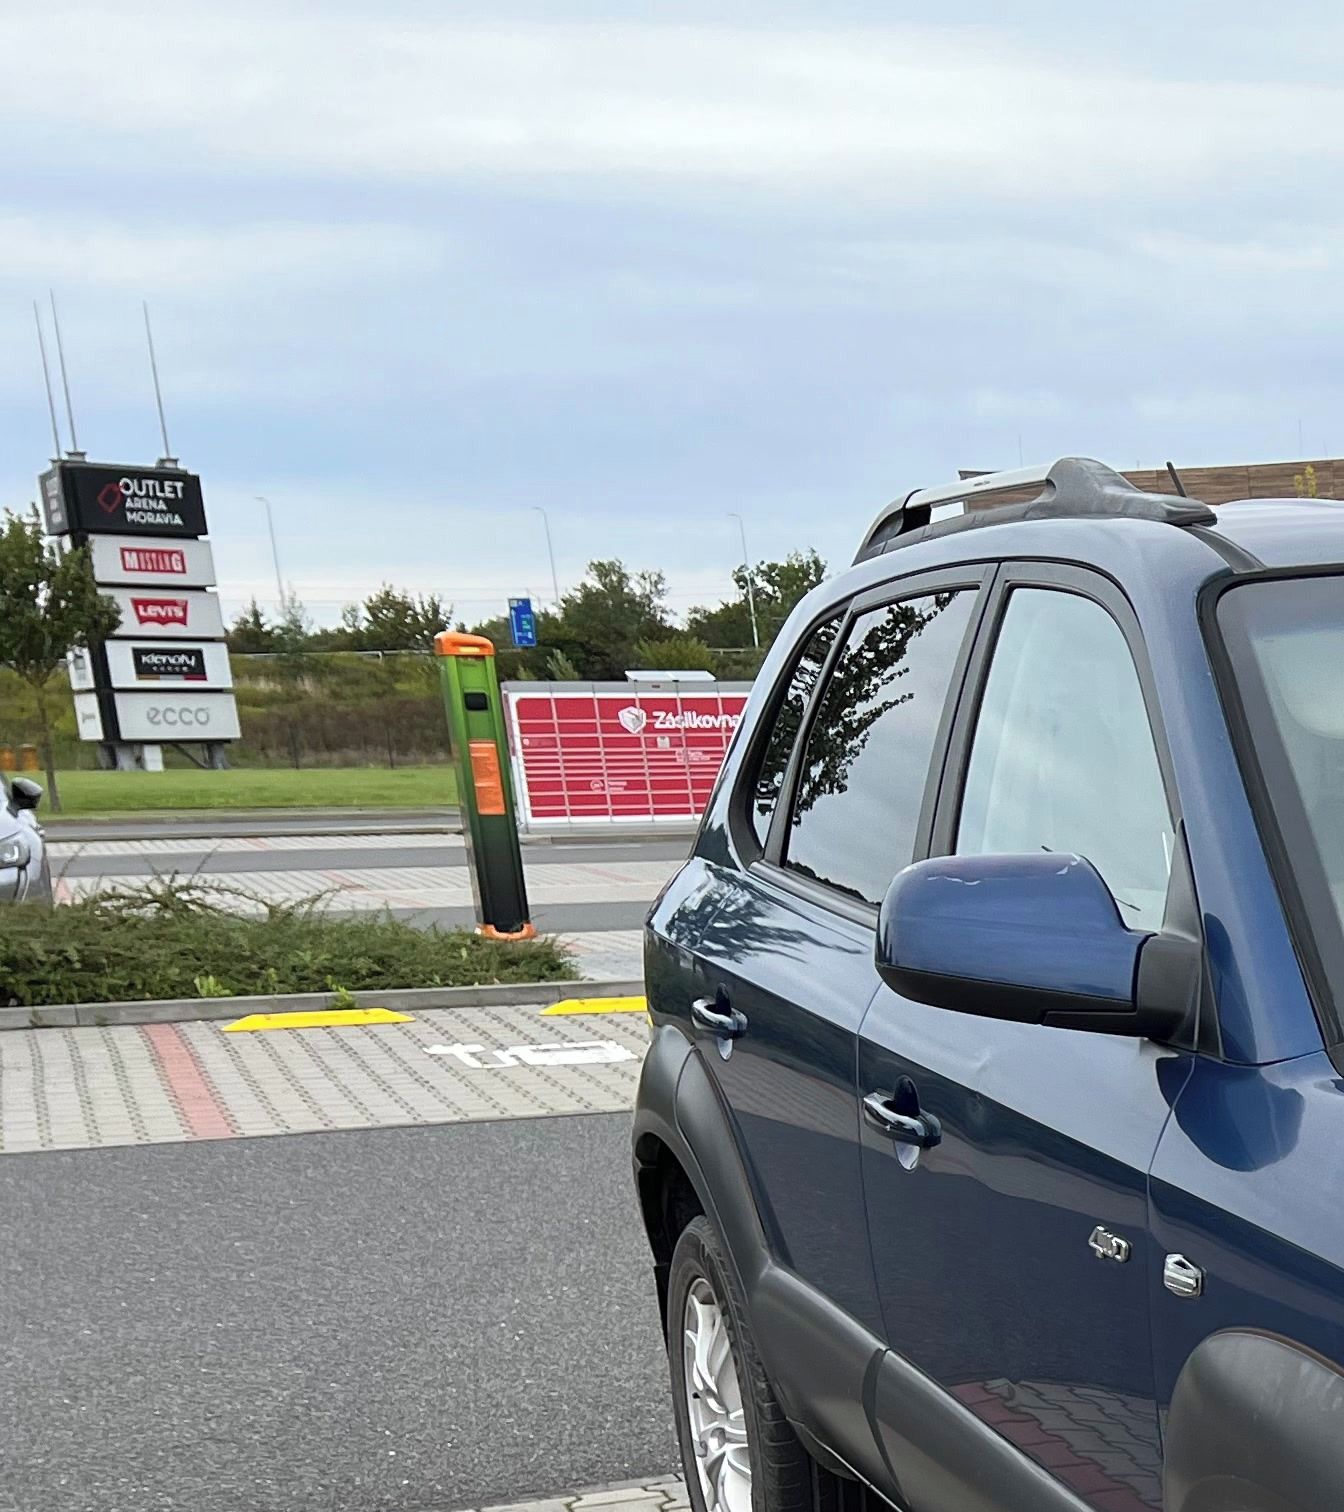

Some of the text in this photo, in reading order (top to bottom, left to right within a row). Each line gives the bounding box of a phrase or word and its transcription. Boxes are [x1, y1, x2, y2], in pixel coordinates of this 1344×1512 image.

[119, 477, 184, 499] OUTLET
[125, 498, 168, 511] ARENA
[126, 510, 184, 526] MORAVIA
[123, 550, 184, 572] MUSTANG
[146, 706, 210, 726] ecco
